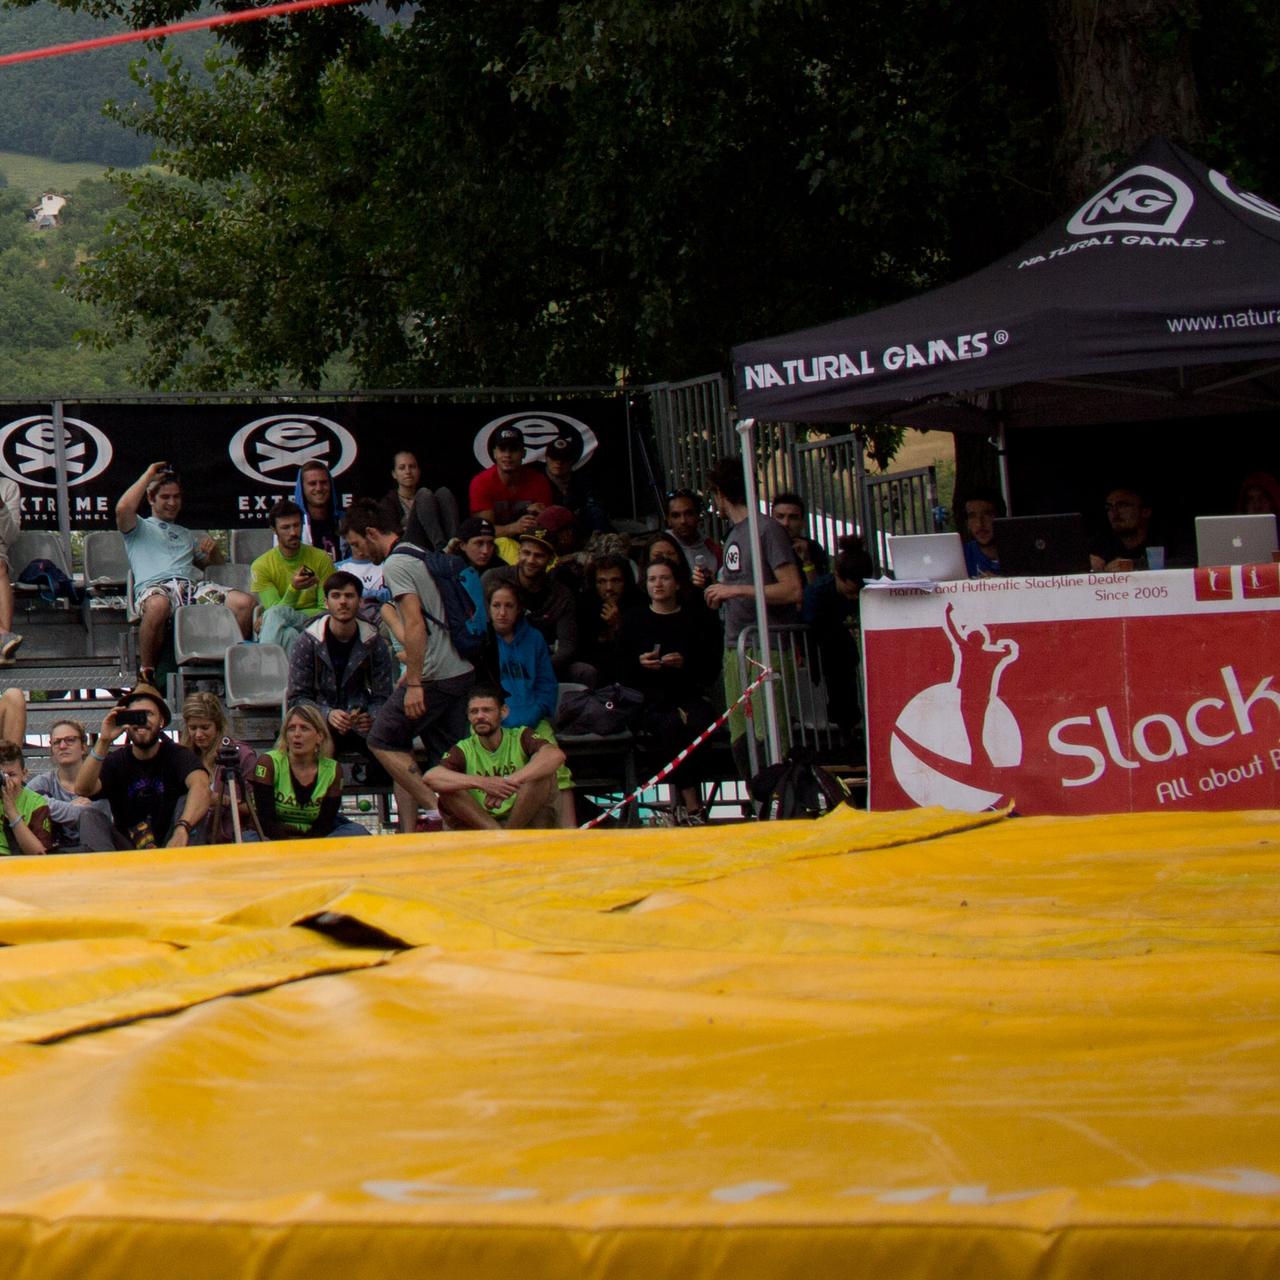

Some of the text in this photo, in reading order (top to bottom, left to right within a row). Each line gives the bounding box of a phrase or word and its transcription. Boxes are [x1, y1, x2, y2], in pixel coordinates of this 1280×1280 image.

[1017, 234, 1210, 269] NATURAL GAMES
[744, 350, 875, 391] NATURAL
[883, 331, 989, 371] GAMES
[935, 583, 958, 594] and
[962, 578, 1020, 593] Authentic
[1025, 575, 1085, 590] Slackline
[1088, 574, 1131, 587] Dealer
[1095, 586, 1169, 602] Since 2005
[1046, 665, 1280, 788] Slack
[1156, 779, 1193, 805] All
[1198, 753, 1265, 792] about
